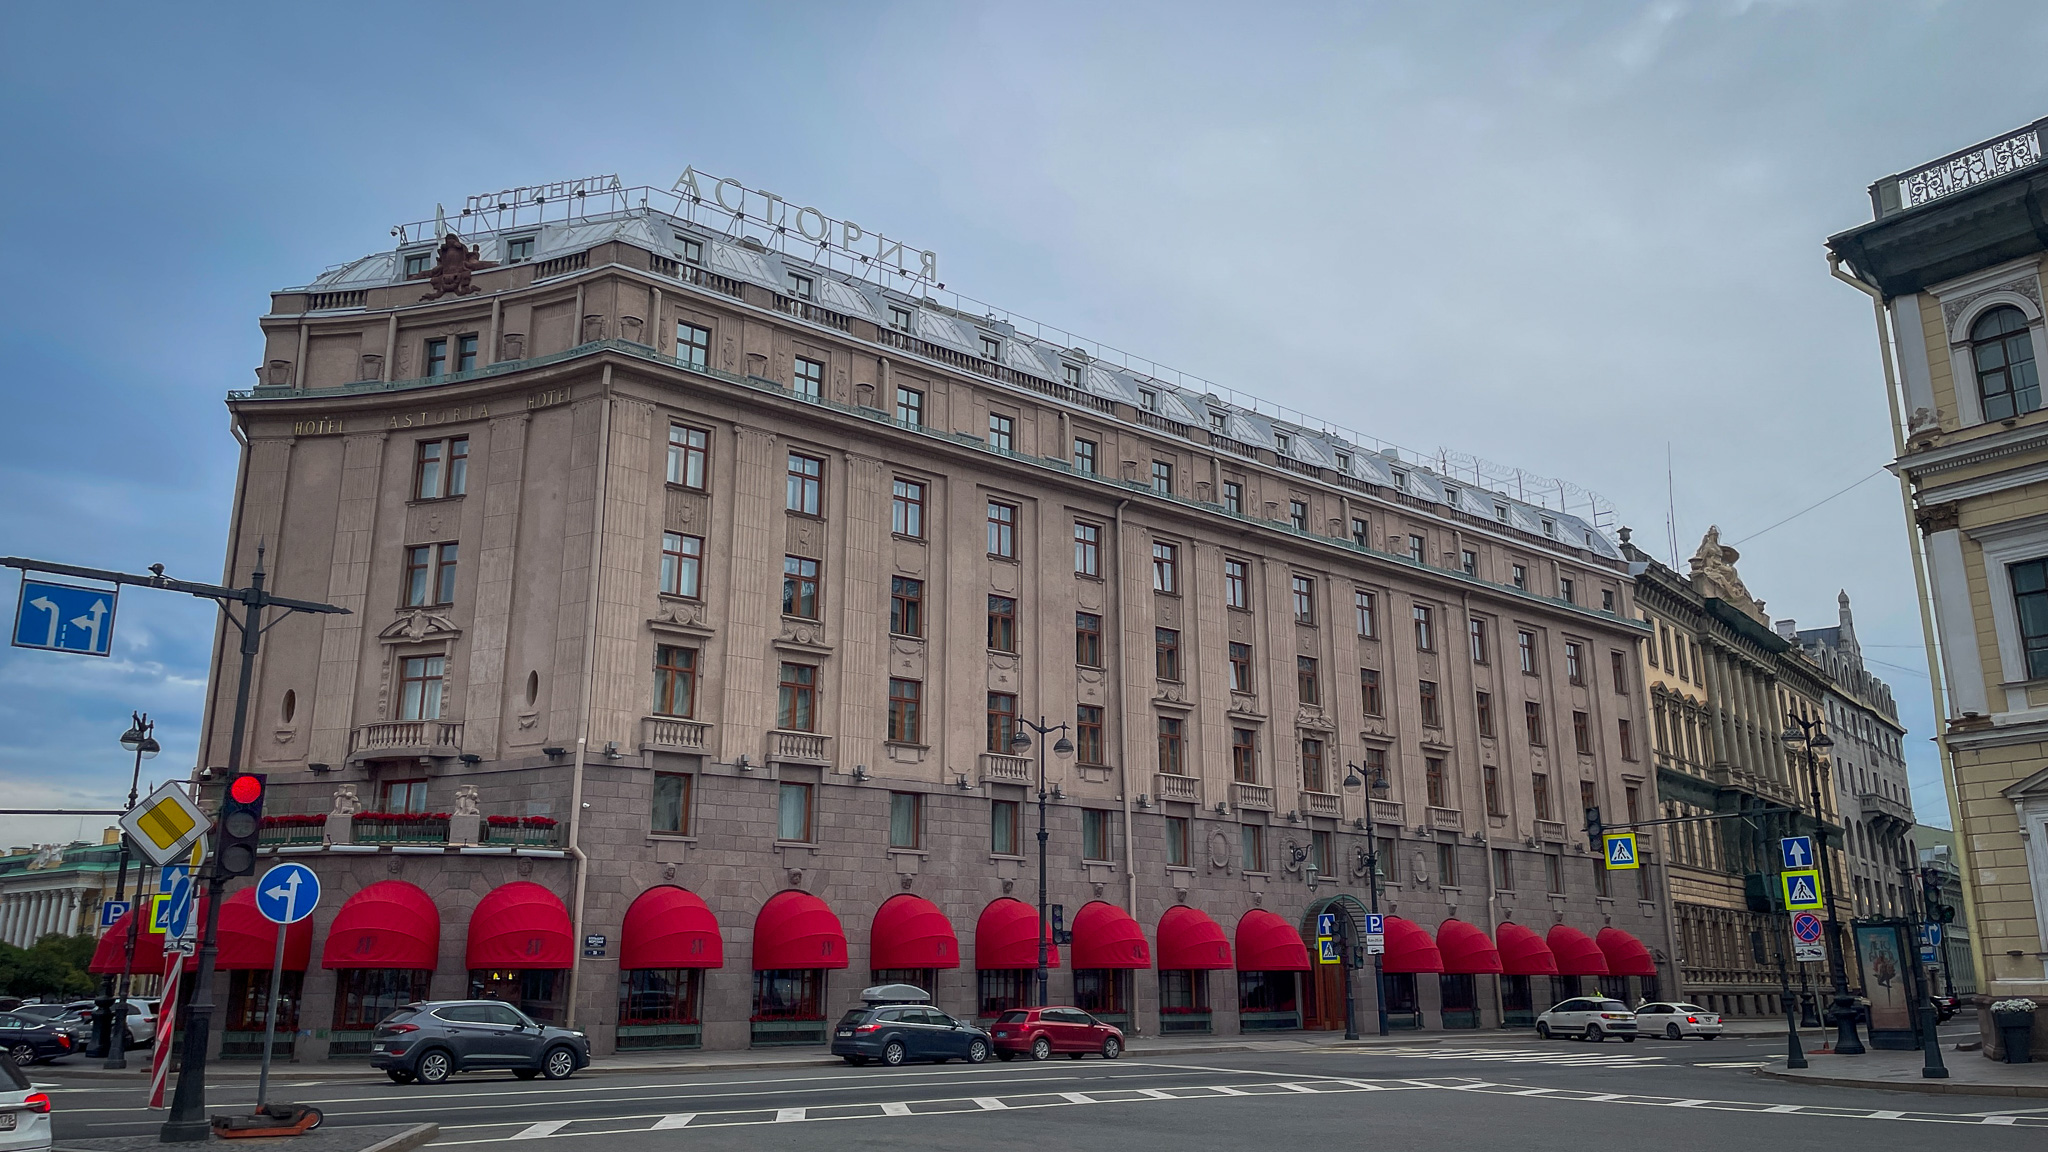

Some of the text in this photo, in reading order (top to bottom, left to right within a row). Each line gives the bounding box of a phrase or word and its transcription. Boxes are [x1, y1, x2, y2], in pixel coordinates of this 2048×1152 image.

[466, 172, 622, 210] ГОСТИНИЦА
[670, 164, 936, 283] АСТОРИЯ
[295, 387, 572, 435] HOTEL ASTORIA HOTEL
[108, 903, 125, 924] P
[1370, 916, 1380, 932] P
